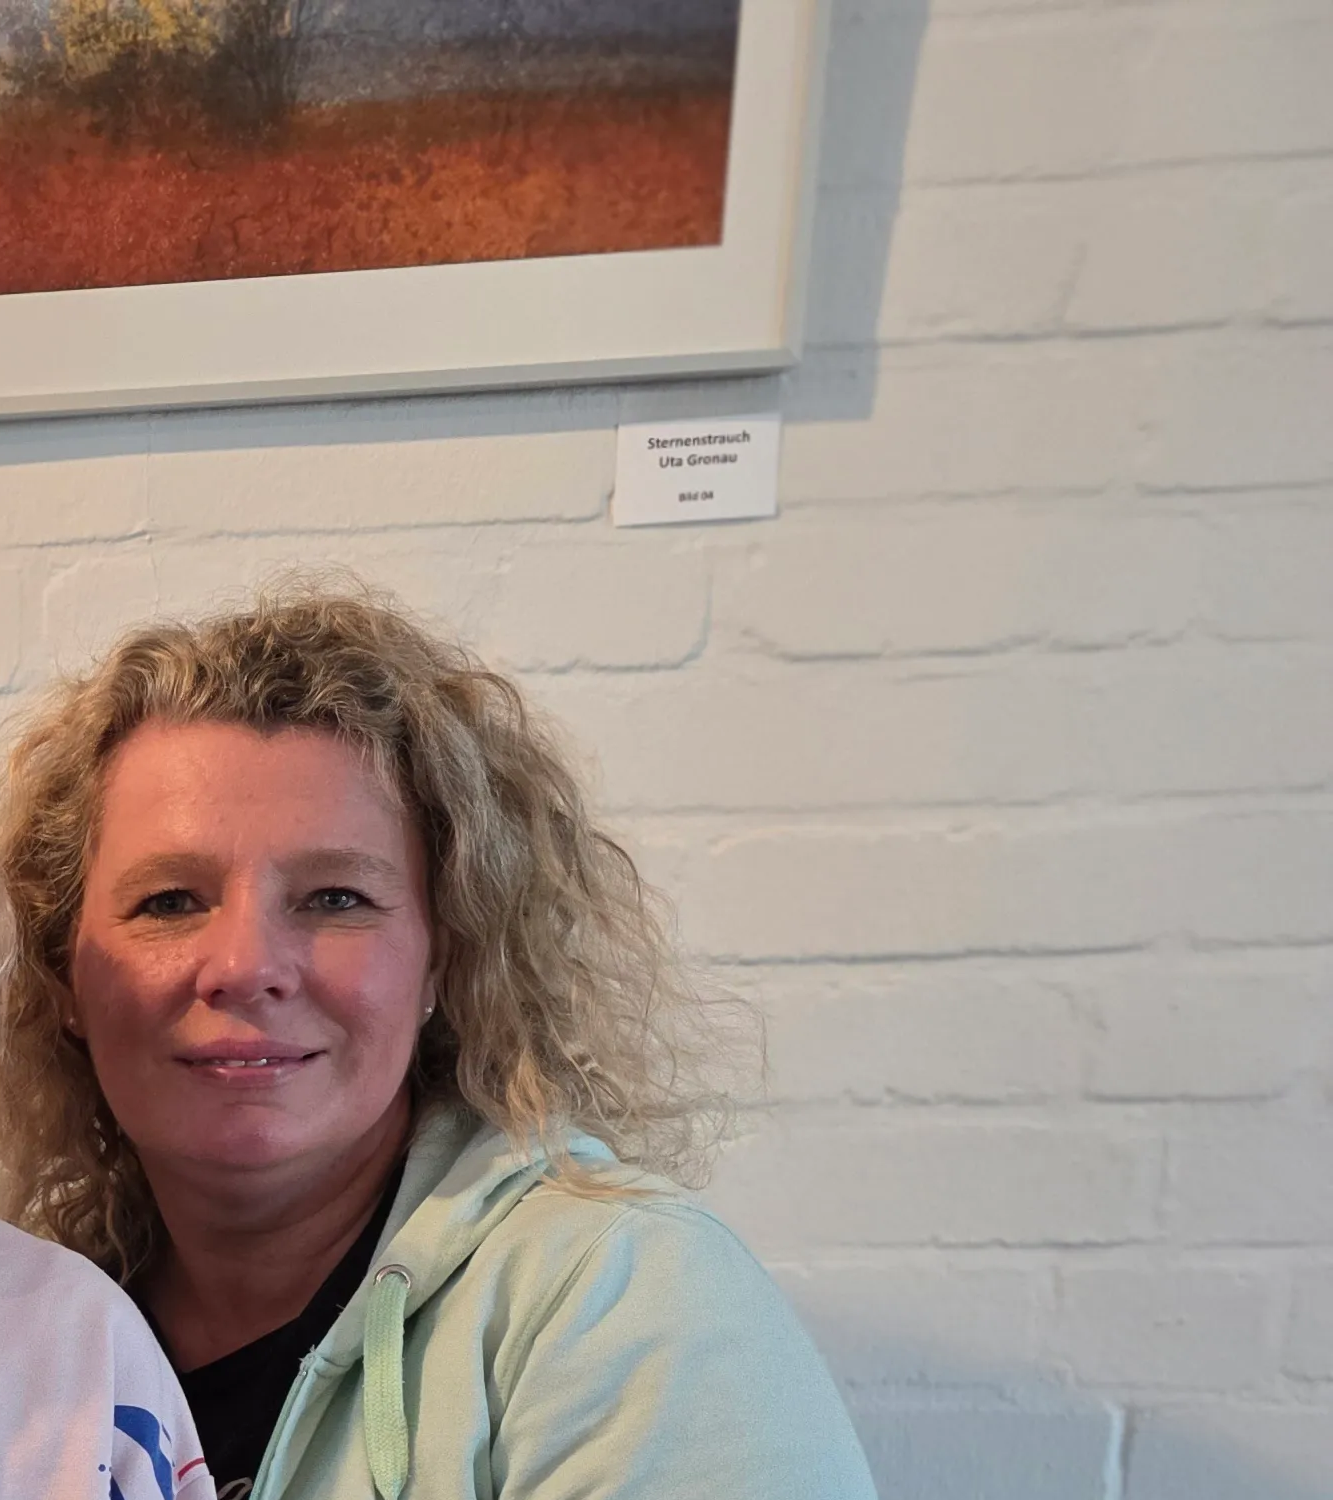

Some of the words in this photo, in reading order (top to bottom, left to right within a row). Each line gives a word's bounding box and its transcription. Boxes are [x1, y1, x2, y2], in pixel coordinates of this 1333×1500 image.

[647, 430, 750, 449] Sternenstrauch
[659, 455, 684, 468] Uta
[687, 453, 738, 467] Gronau
[678, 492, 699, 502] Bild
